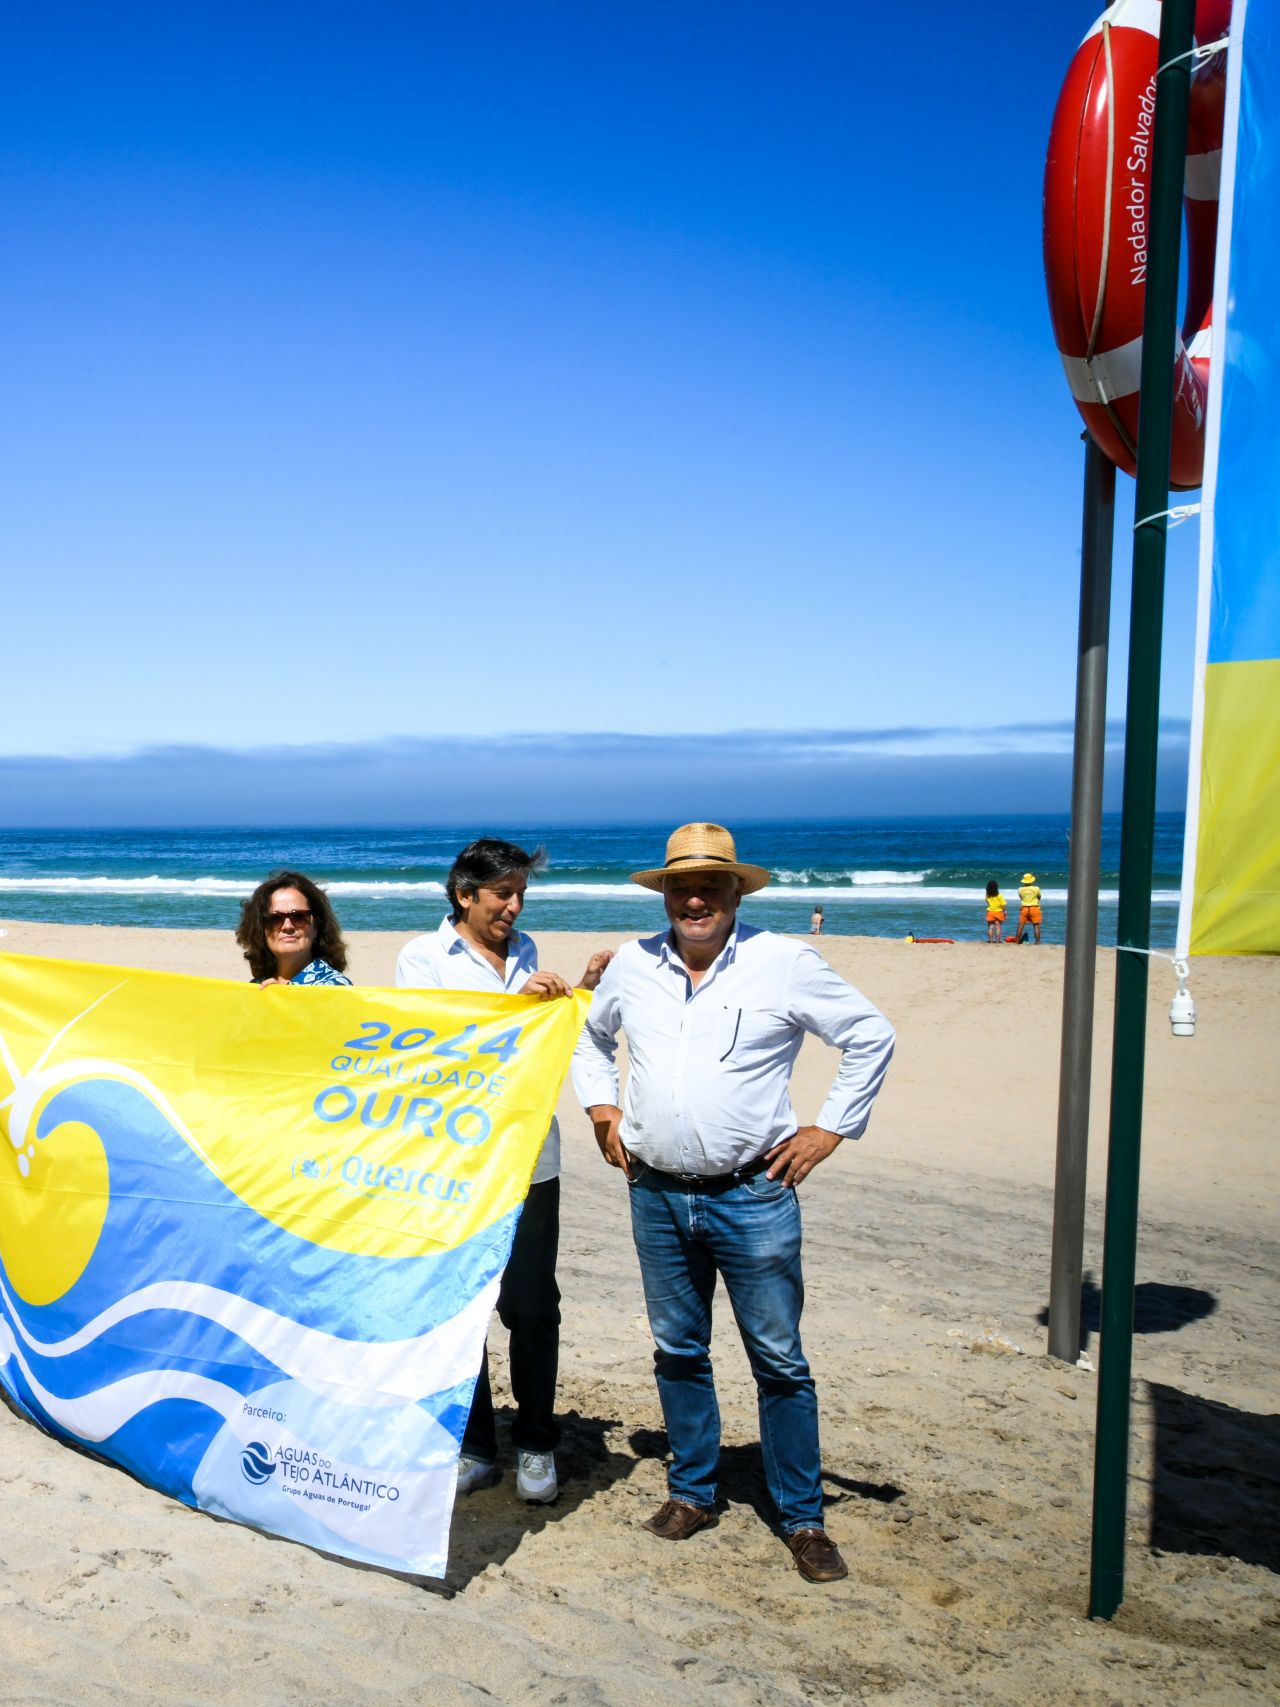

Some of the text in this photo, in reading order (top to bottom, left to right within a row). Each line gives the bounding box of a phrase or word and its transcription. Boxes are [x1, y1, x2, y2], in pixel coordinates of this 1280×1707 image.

[1126, 75, 1157, 285] Nadador Salvador
[343, 1021, 522, 1062] 2024
[330, 1055, 507, 1096] QUALIDADE
[313, 1085, 492, 1147] OURO
[340, 1155, 473, 1204] Quercus
[242, 1402, 287, 1422] Parceiro:
[280, 1461, 400, 1501] TEJO ATLÂNTICO
[319, 1459, 331, 1469] DO
[326, 1496, 336, 1504] de
